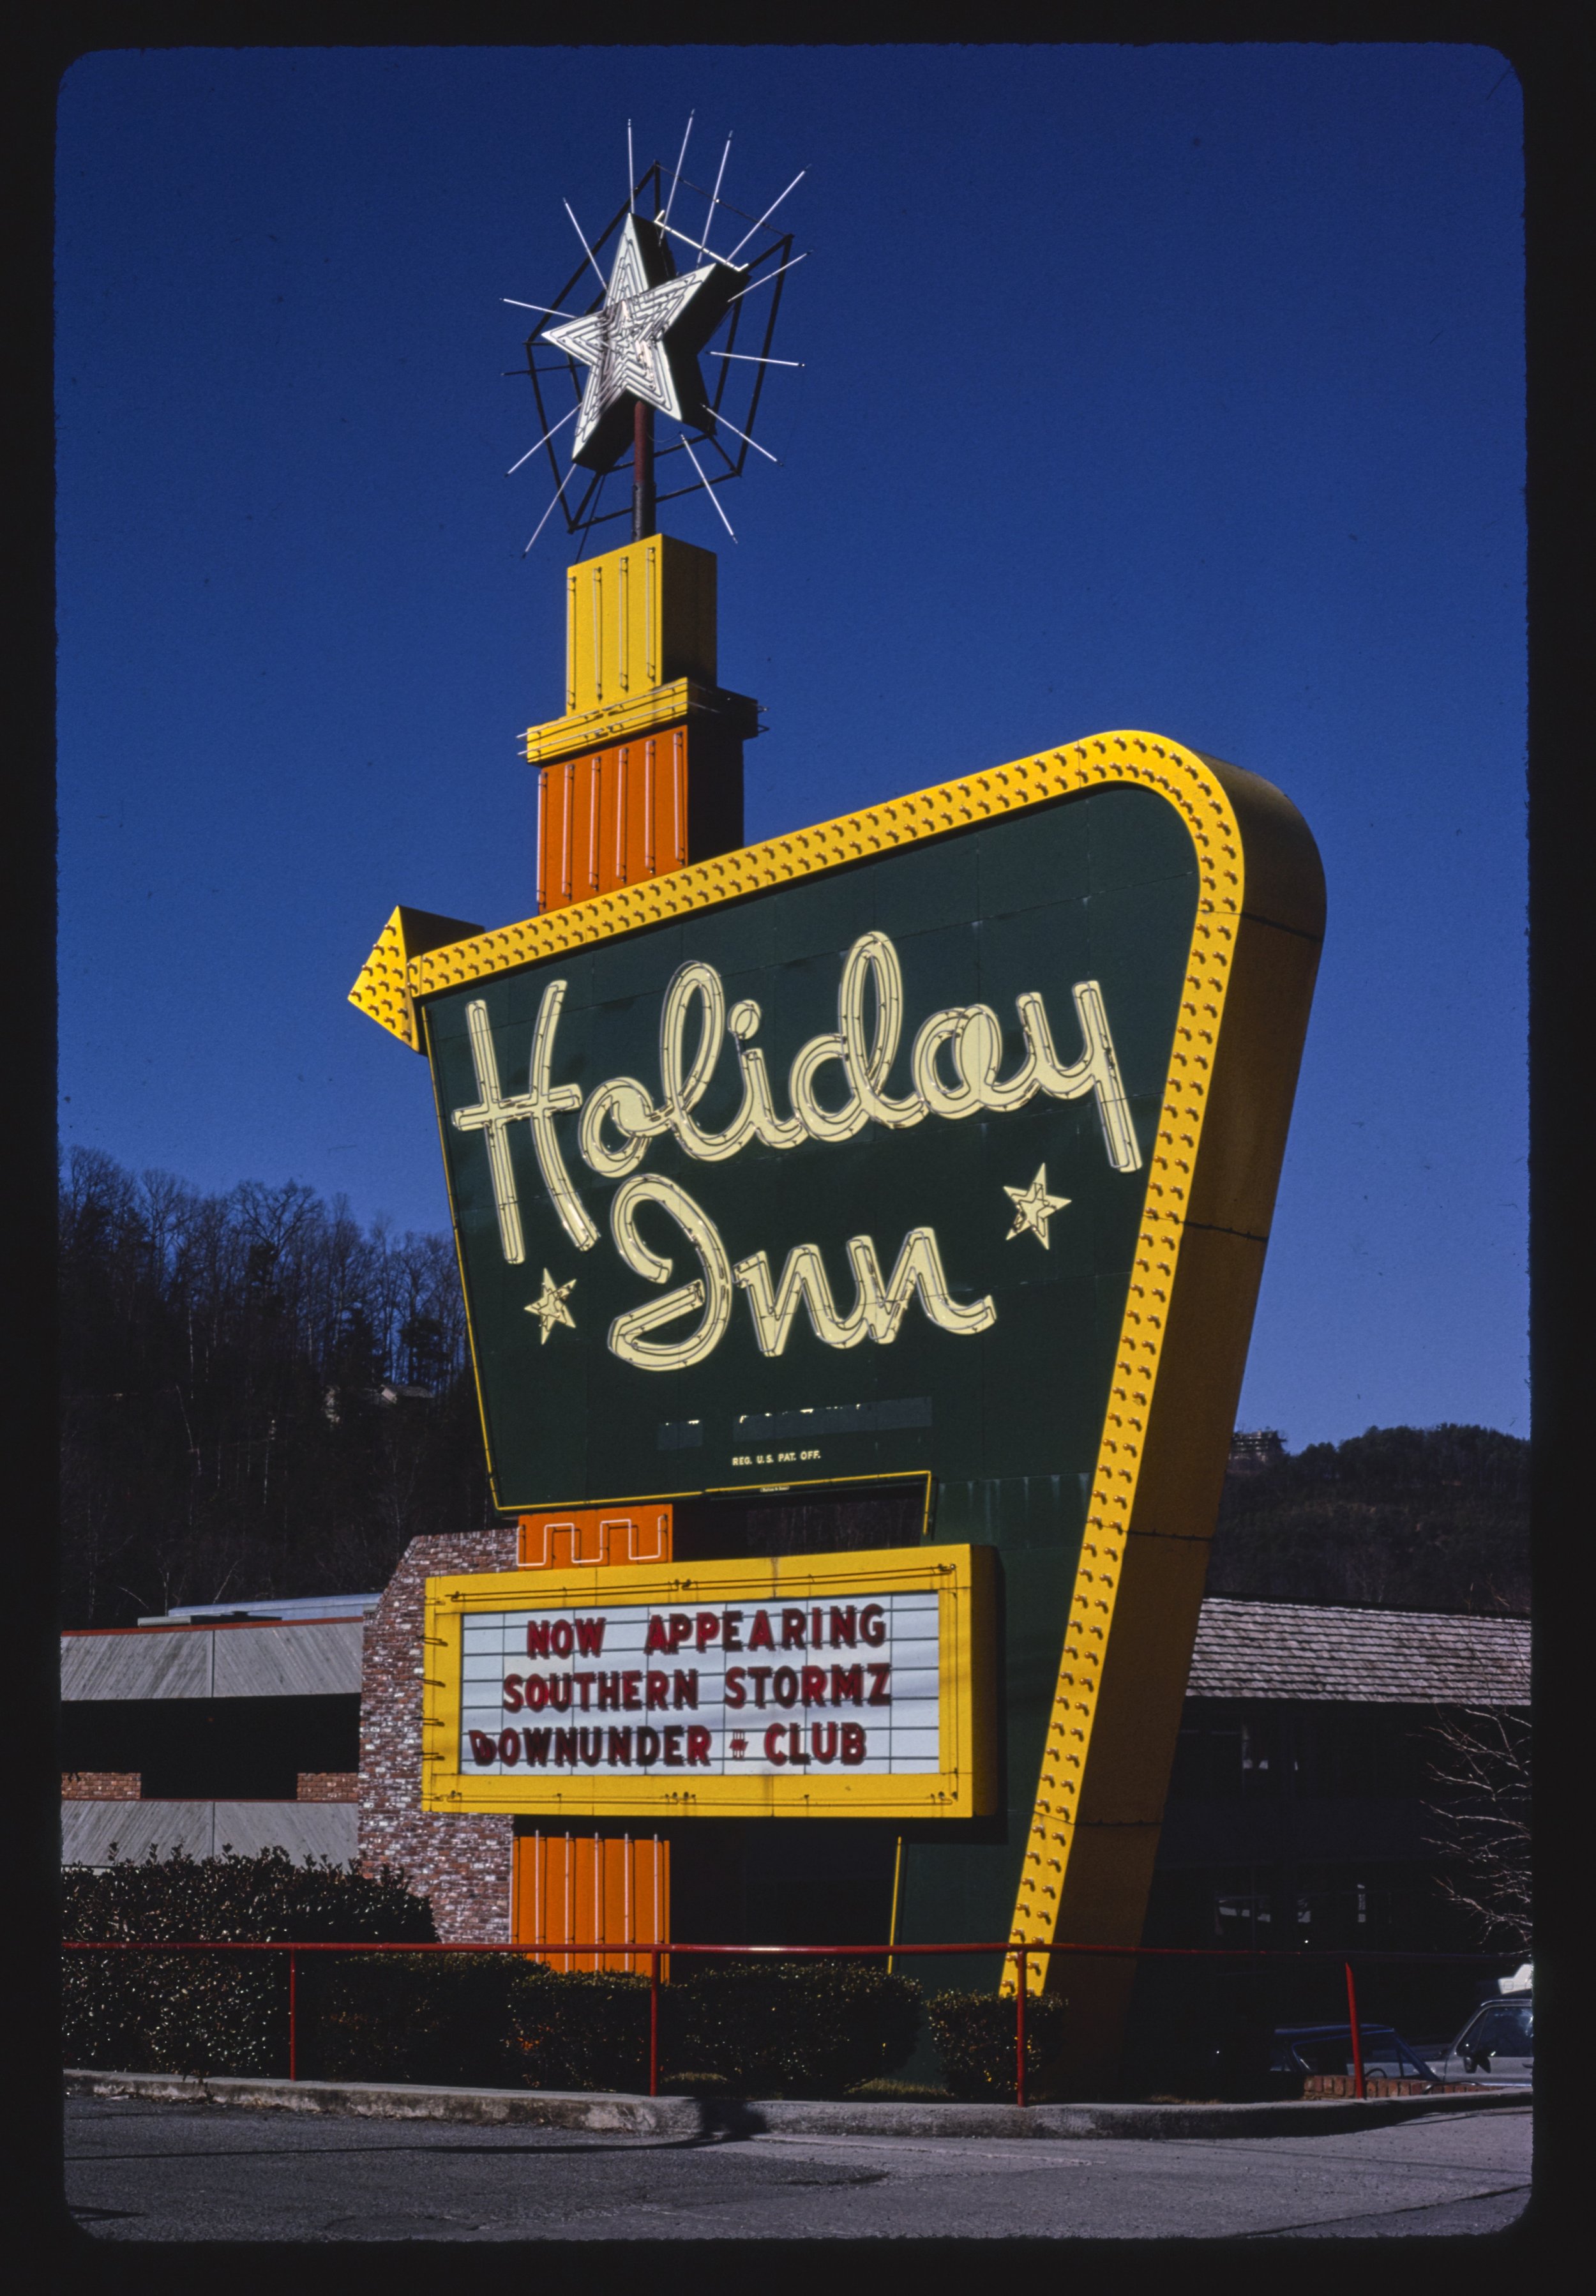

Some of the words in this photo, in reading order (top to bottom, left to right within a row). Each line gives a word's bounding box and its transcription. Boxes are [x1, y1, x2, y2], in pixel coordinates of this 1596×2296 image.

[451, 930, 1142, 1264] Holiday
[607, 1173, 997, 1371] Inn
[732, 1456, 753, 1467] REG.
[778, 1451, 797, 1463] PAT.
[800, 1450, 821, 1461] OFF.
[526, 1617, 606, 1659] NOW
[645, 1603, 886, 1655] APPEARING
[502, 1668, 699, 1714] SOUTHERN
[723, 1662, 892, 1709] STORMZ
[469, 1725, 712, 1768] DOWNUNDER
[764, 1721, 867, 1767] CLUB
